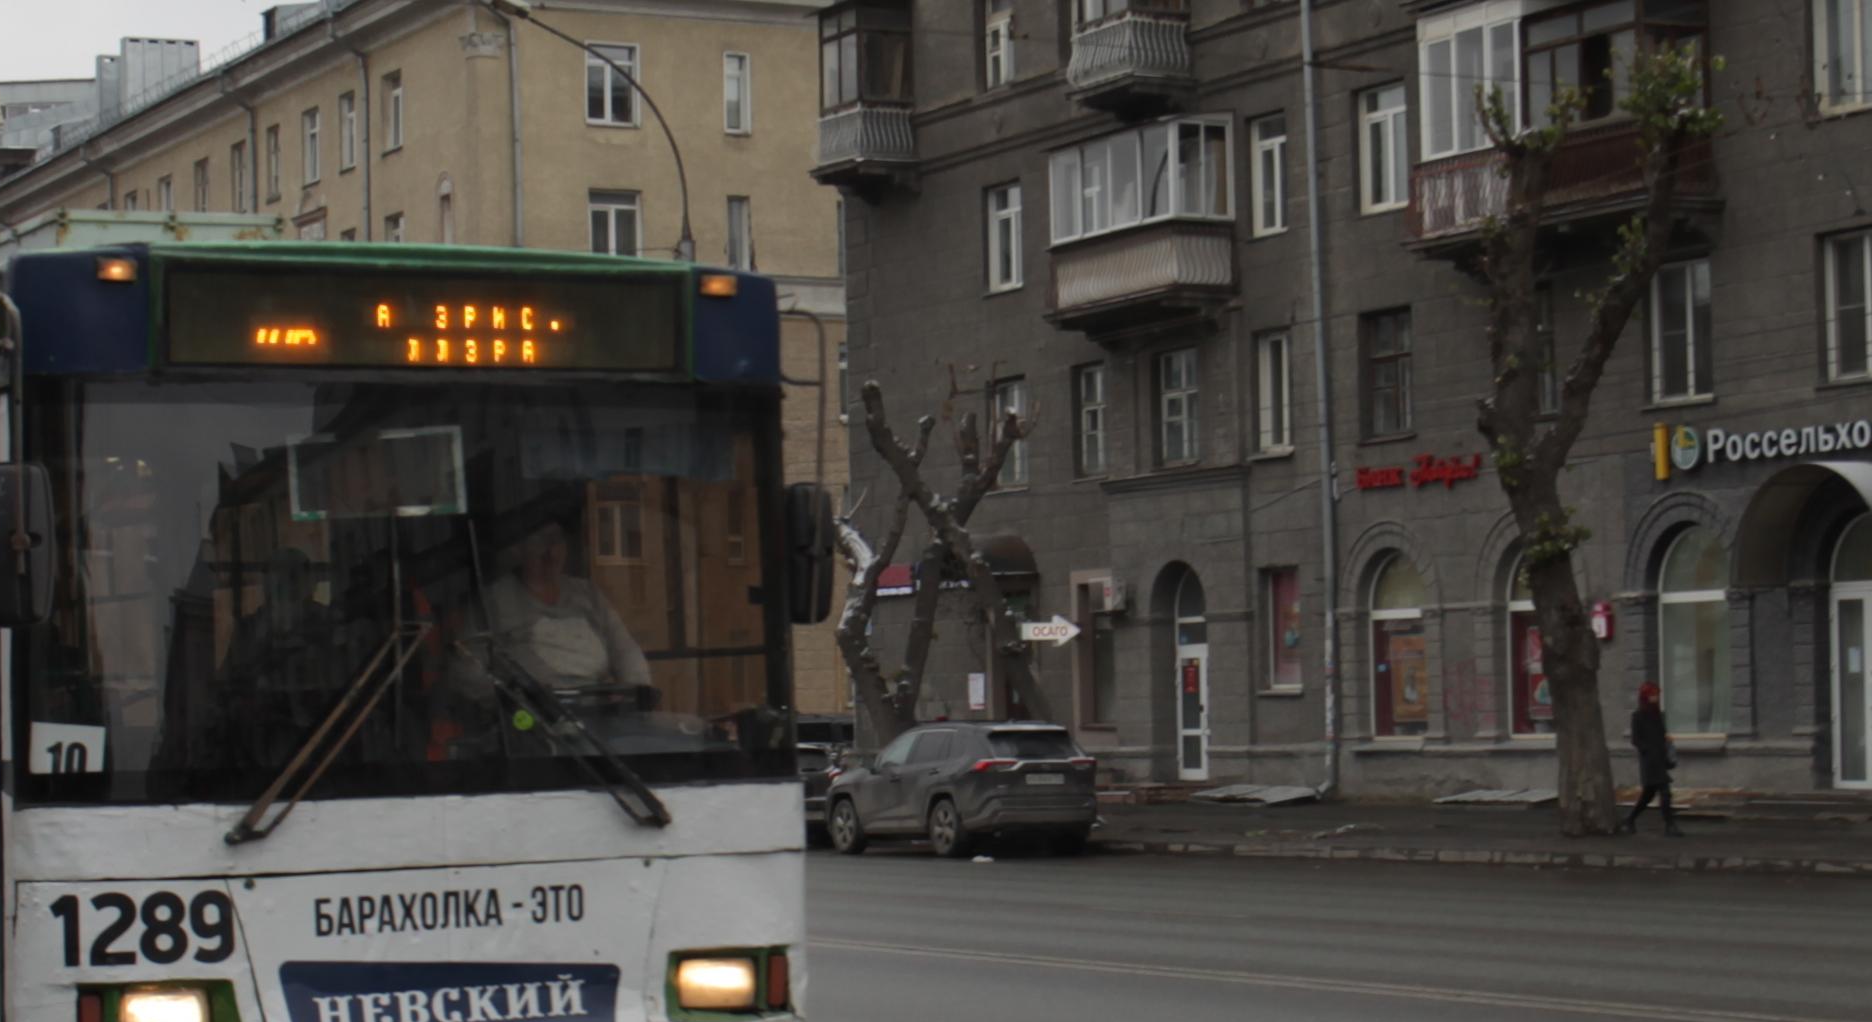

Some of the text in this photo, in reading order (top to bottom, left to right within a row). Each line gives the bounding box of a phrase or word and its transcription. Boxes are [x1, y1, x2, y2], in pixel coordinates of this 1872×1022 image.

[46, 741, 87, 774] 10
[49, 889, 235, 967] 1289
[314, 888, 503, 937] БАРАХОЛКА
[531, 884, 584, 924] ЭТО
